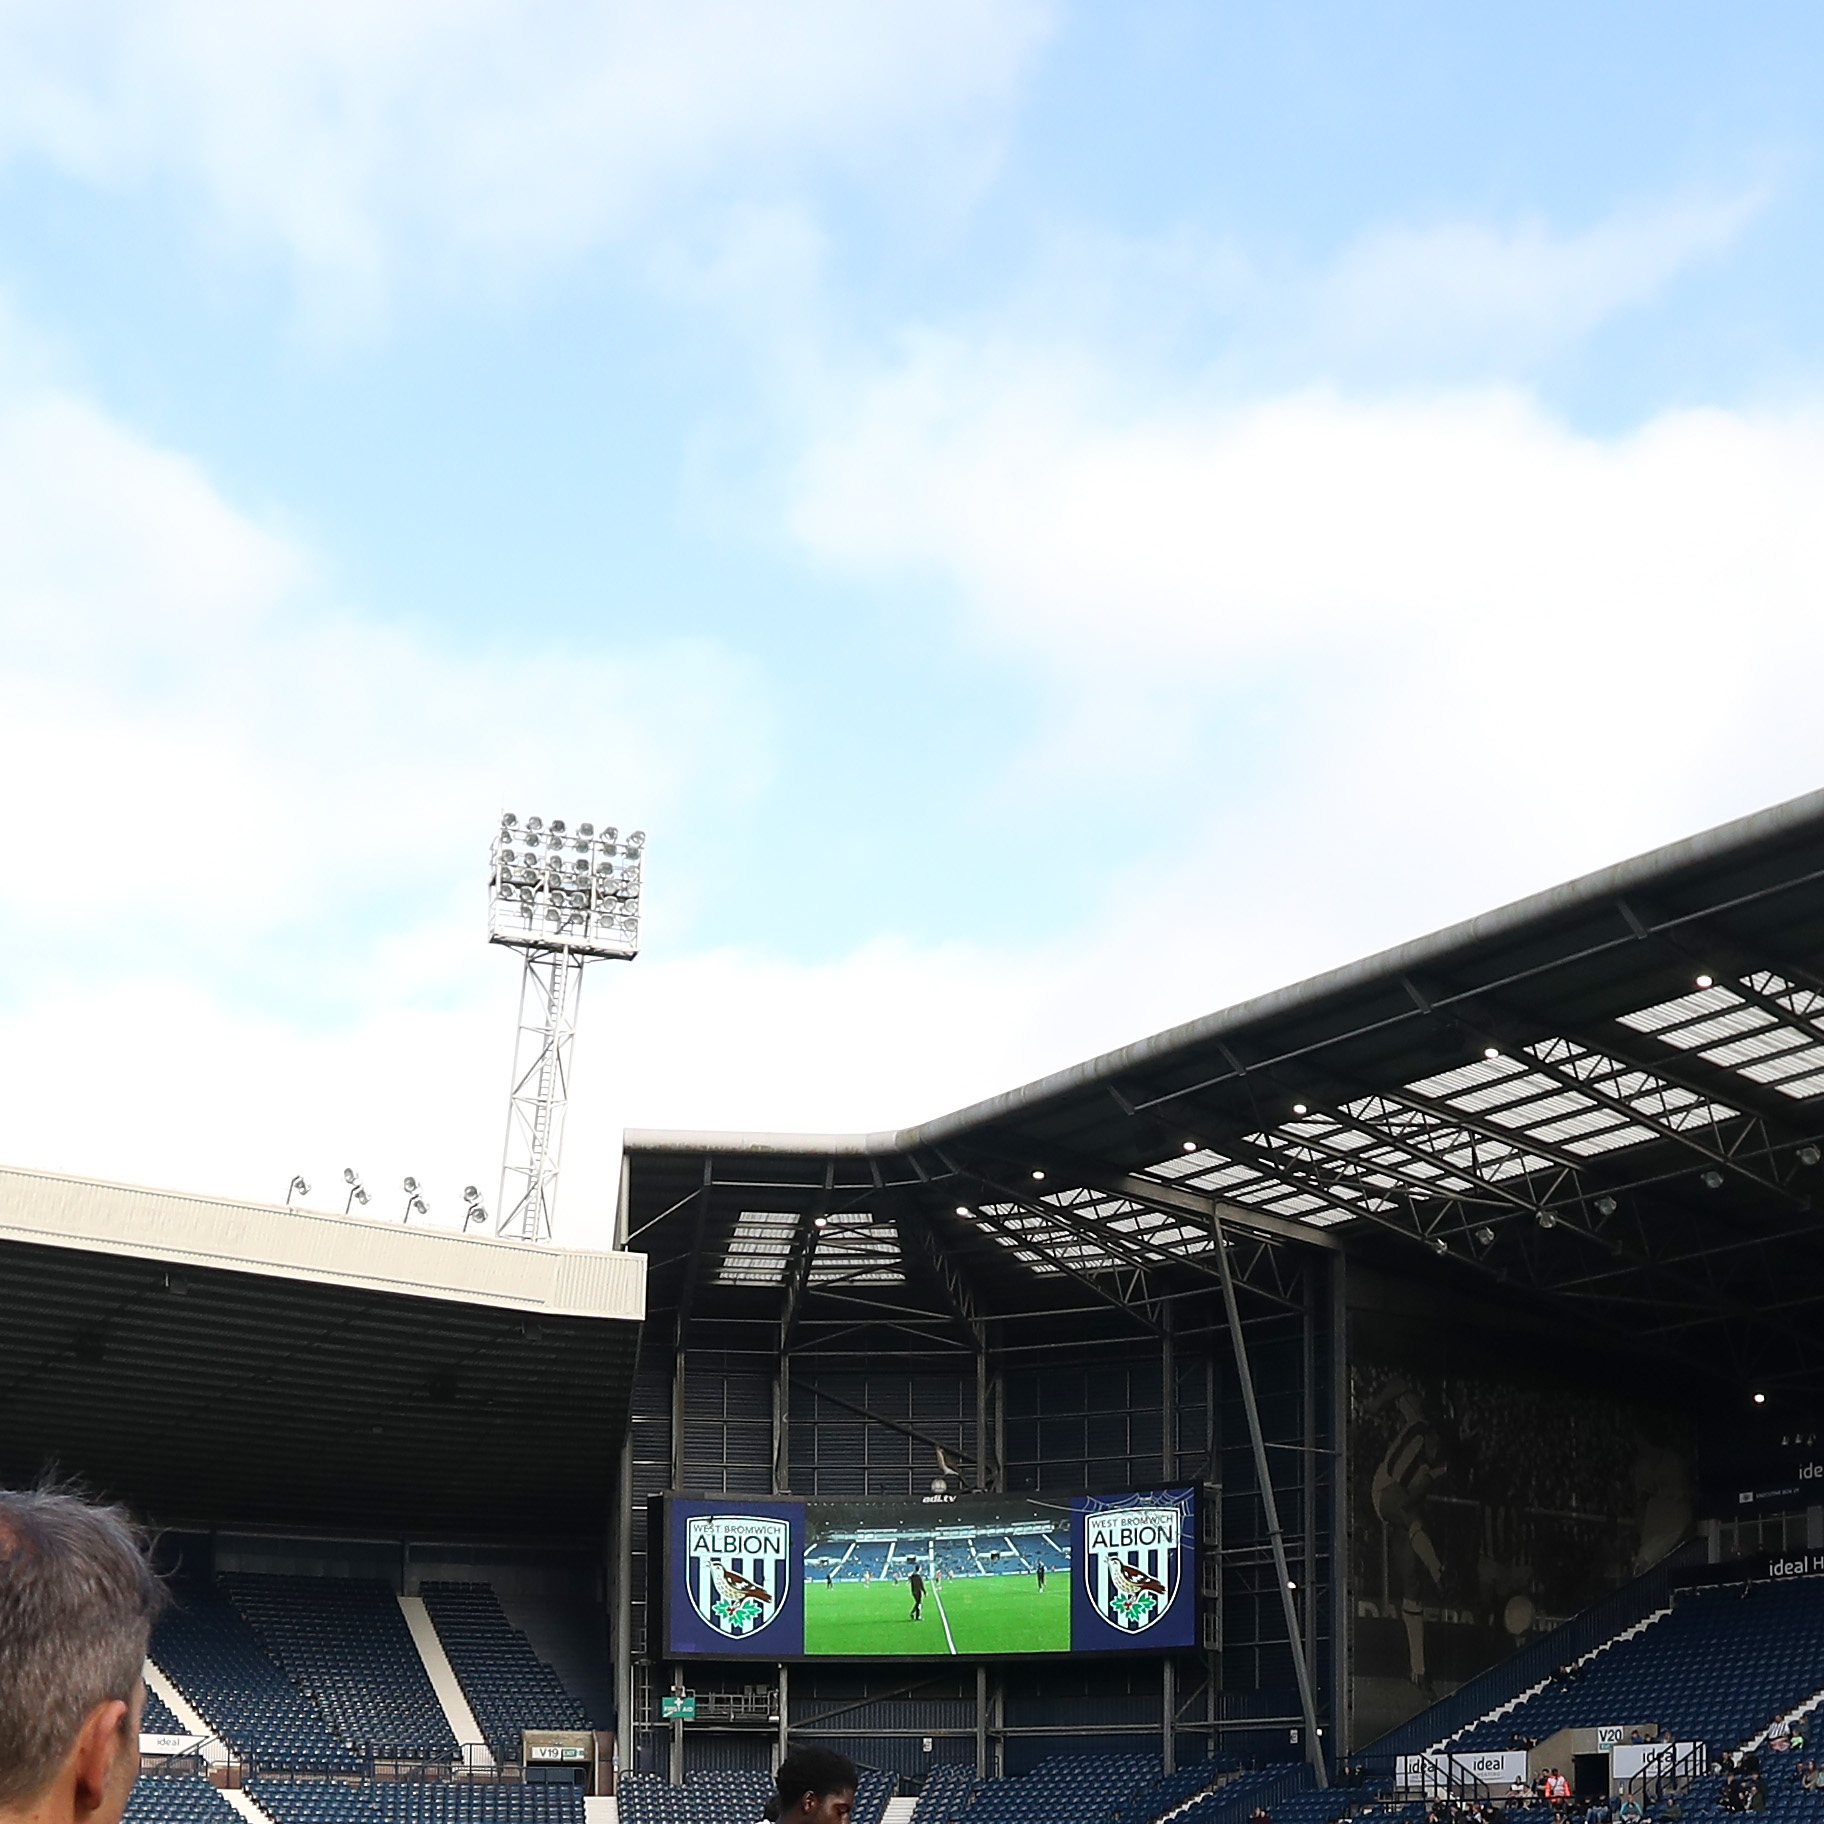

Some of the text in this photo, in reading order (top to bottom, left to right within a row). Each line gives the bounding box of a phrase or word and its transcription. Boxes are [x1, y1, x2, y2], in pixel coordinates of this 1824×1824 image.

[693, 1524, 782, 1537] WEST BROMWICH
[1091, 1515, 1174, 1531] WEST BROMWICH
[692, 1535, 781, 1556] ALBION
[1091, 1526, 1173, 1551] ALBION
[1769, 1555, 1808, 1577] ideal
[157, 1737, 181, 1748] ideal
[1599, 1729, 1623, 1743] V20
[539, 1748, 560, 1759] V19
[1472, 1755, 1505, 1772] ideal
